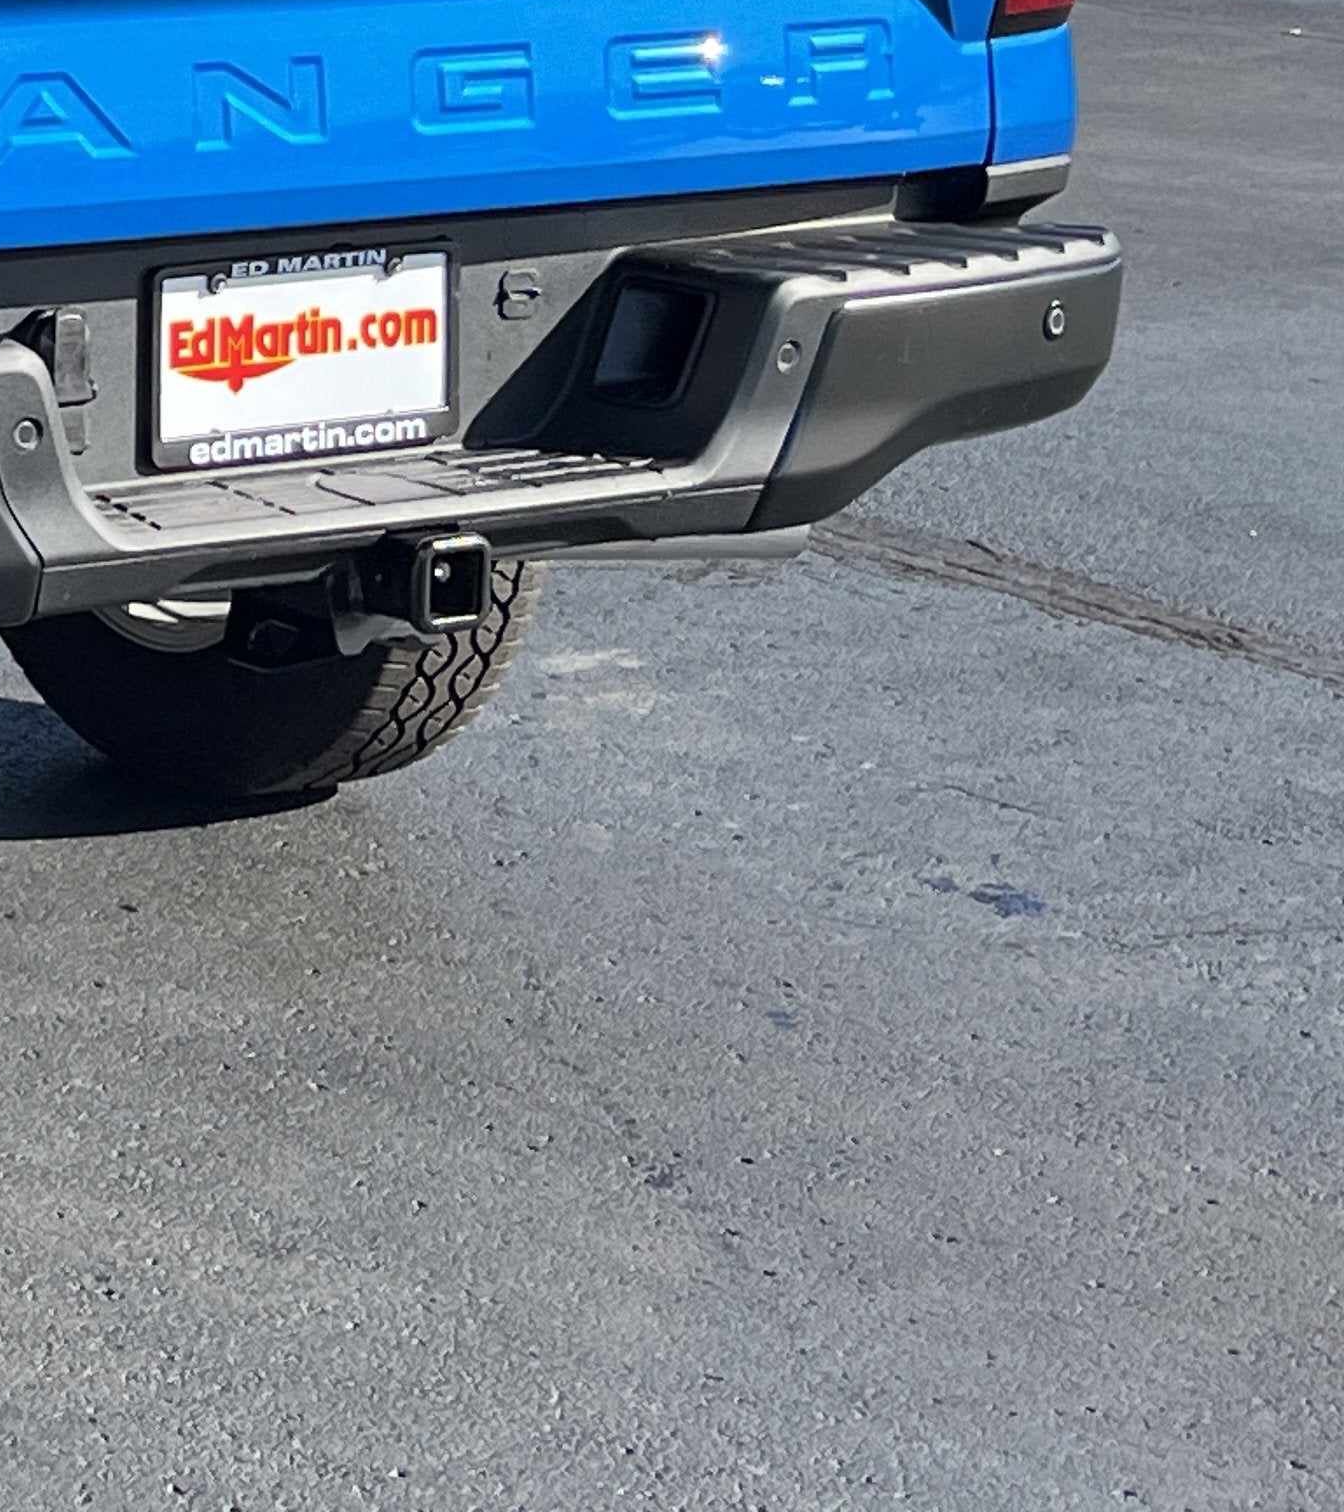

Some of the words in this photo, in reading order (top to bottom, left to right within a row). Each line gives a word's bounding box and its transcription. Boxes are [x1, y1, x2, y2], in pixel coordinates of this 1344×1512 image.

[232, 261, 269, 277] ED
[277, 249, 386, 273] MARTIN
[189, 418, 427, 464] edmartin.com
